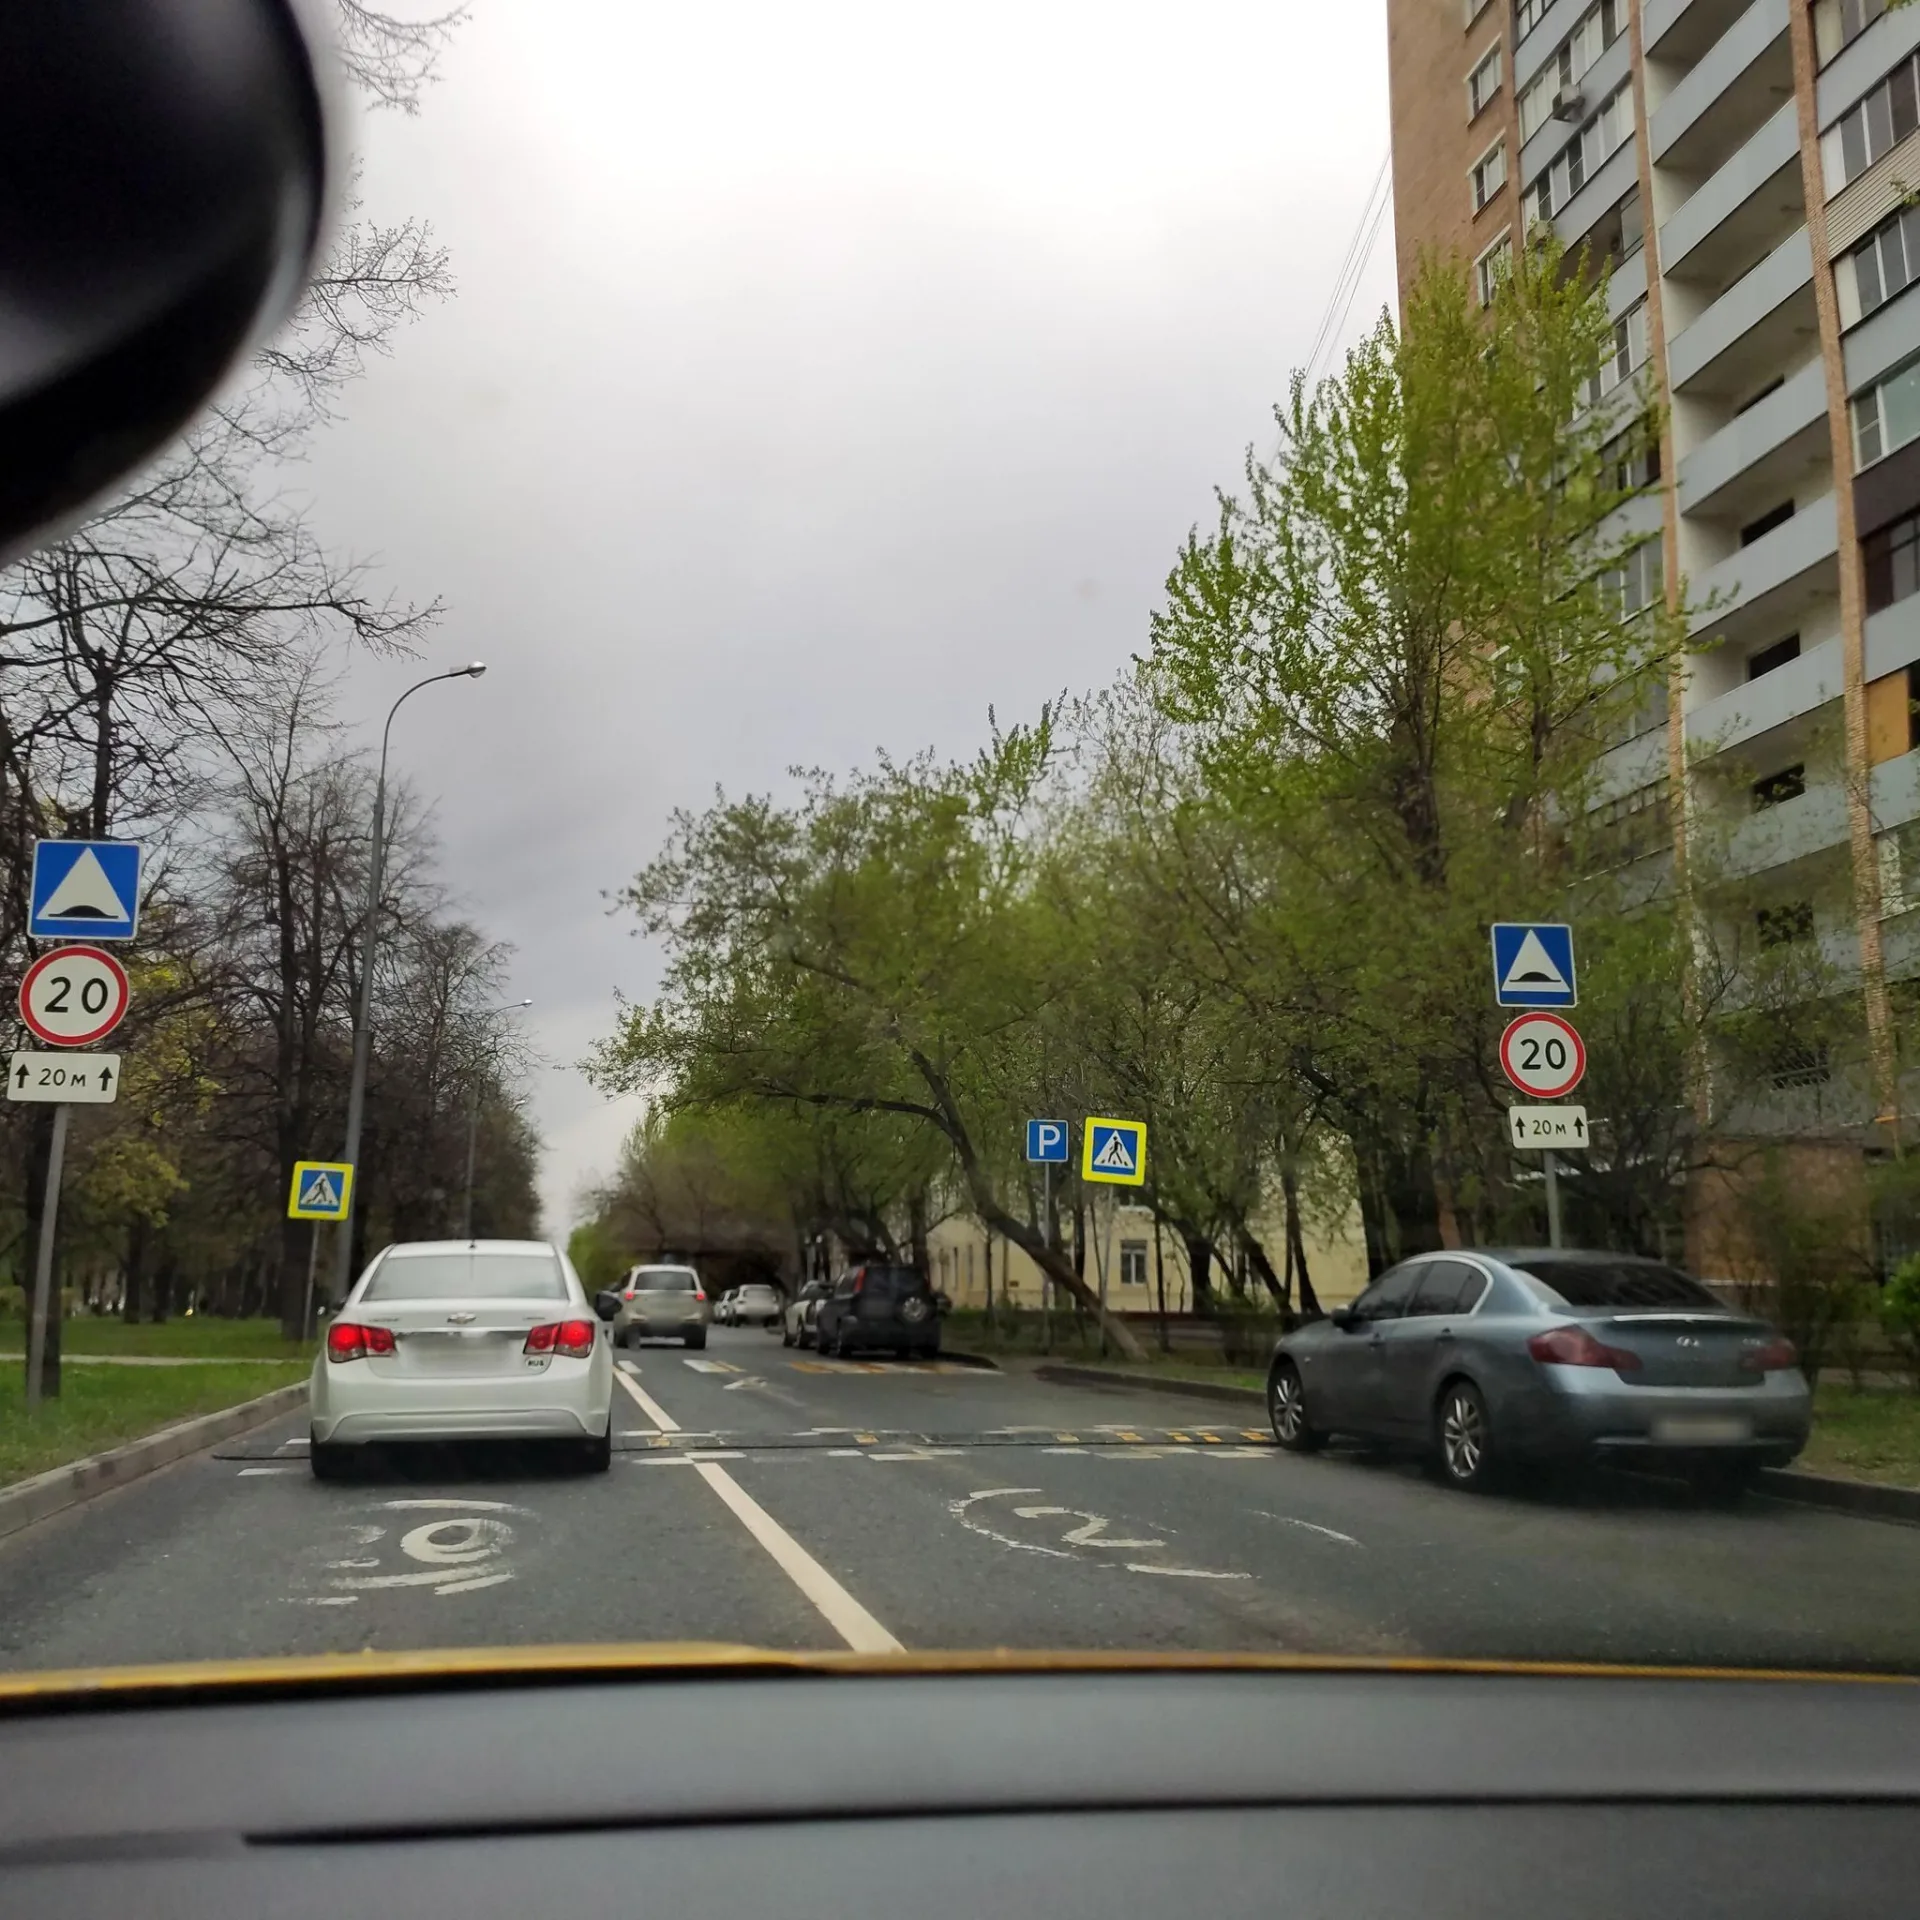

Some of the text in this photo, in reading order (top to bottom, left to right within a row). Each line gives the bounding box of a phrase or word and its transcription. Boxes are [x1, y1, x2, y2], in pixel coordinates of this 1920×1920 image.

[44, 976, 109, 1014] 20
[1520, 1038, 1567, 1070] 20
[38, 1068, 66, 1086] 20
[1039, 1124, 1061, 1157] P
[1532, 1119, 1552, 1135] 20
